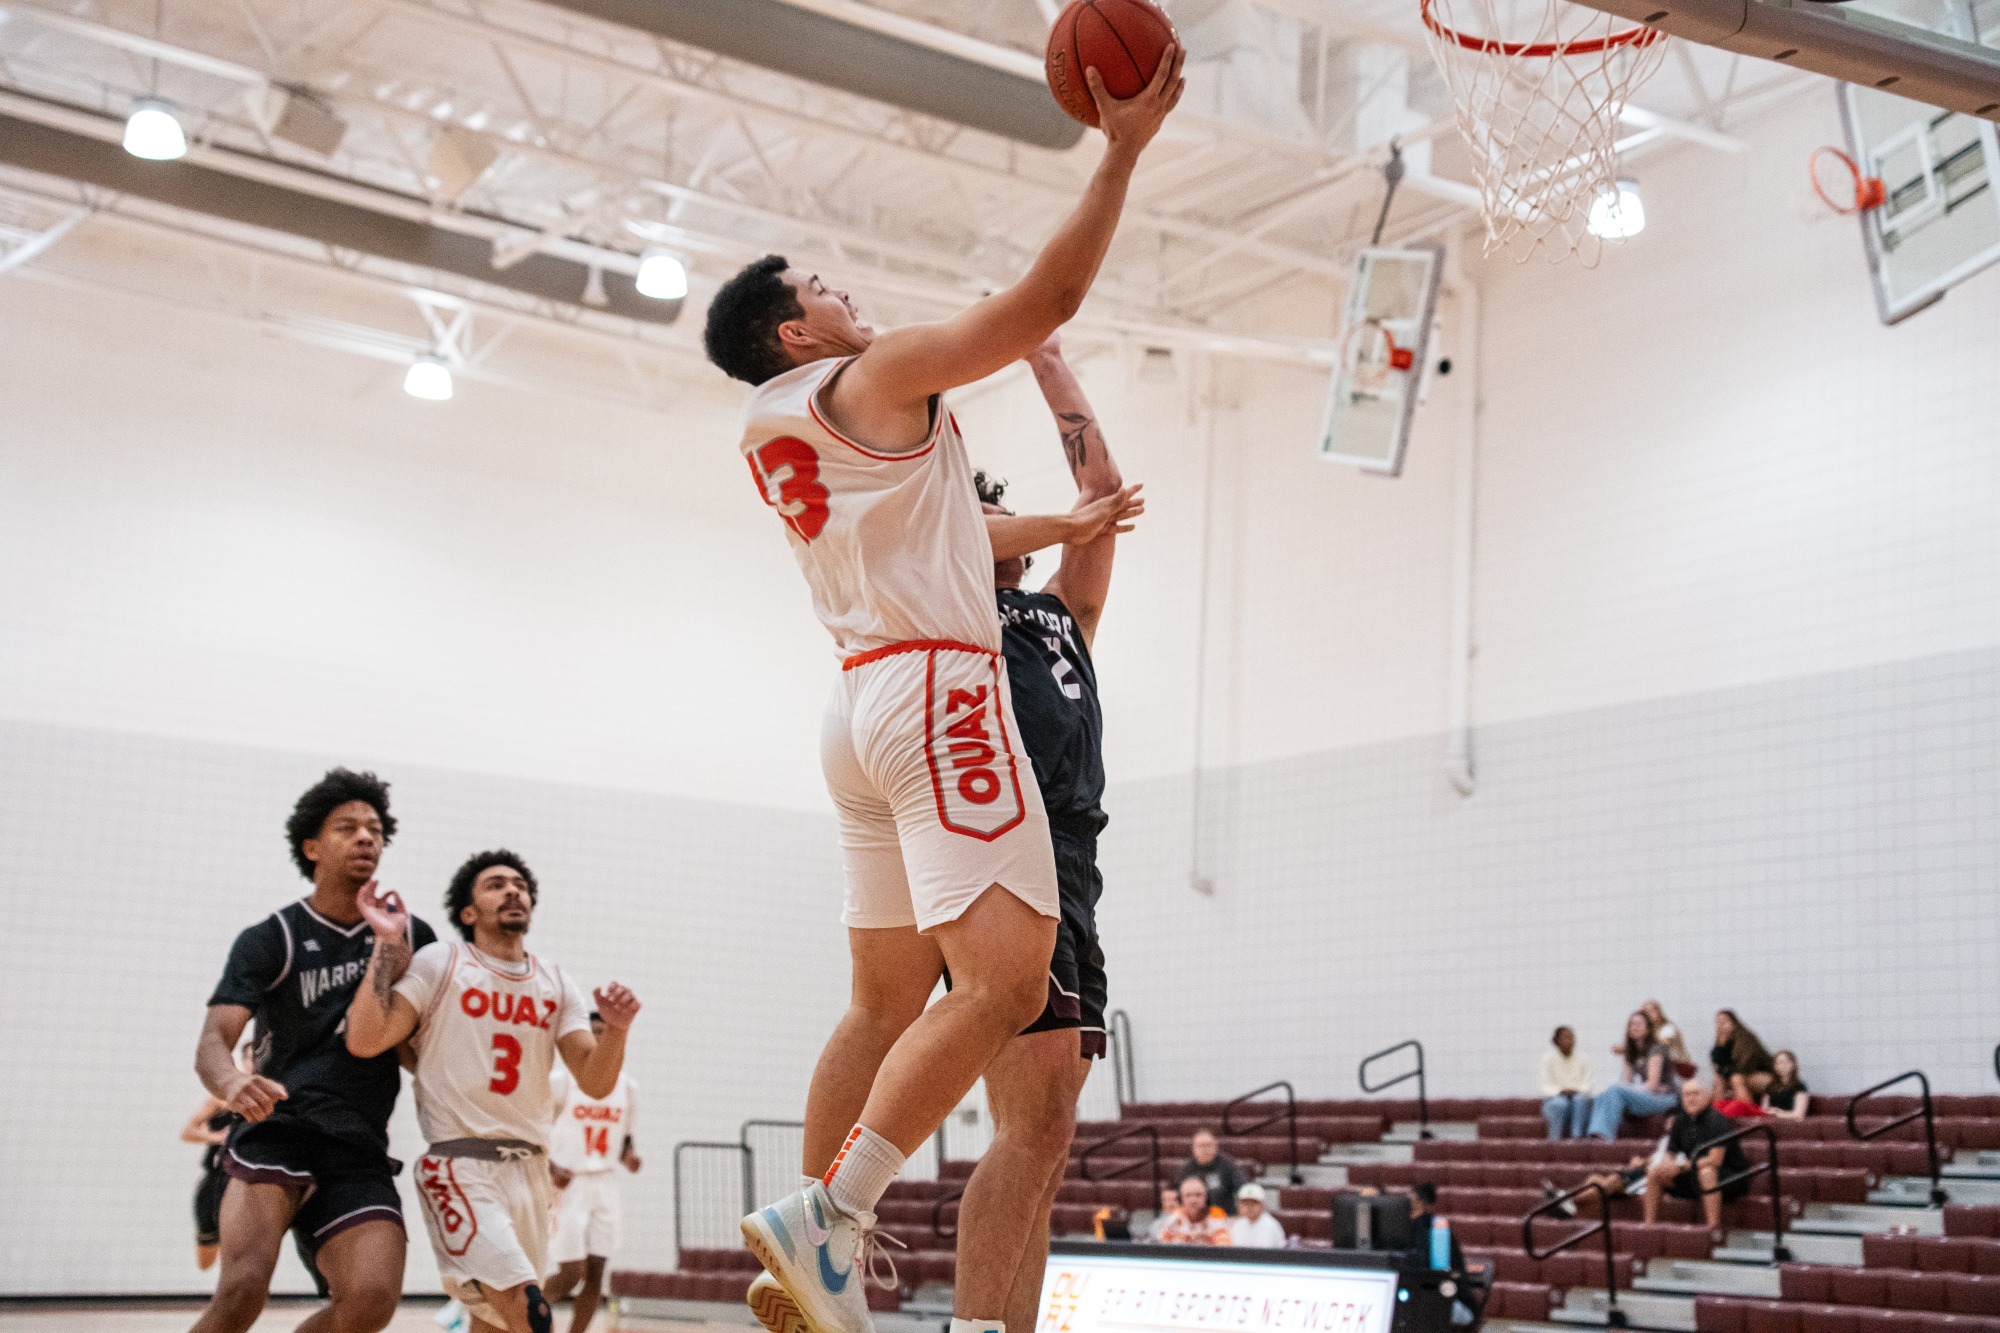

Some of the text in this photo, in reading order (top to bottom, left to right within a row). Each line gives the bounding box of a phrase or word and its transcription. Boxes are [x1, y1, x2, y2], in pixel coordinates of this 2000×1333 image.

[1042, 636, 1082, 700] 2
[945, 684, 1001, 805] OUAZ
[460, 986, 557, 1031] OUAZ
[489, 1033, 523, 1096] 3
[573, 1104, 623, 1123] OUAZ
[584, 1126, 609, 1157] 14
[1171, 1291, 1252, 1325] SPORTS
[1261, 1298, 1373, 1333] NETWORK
